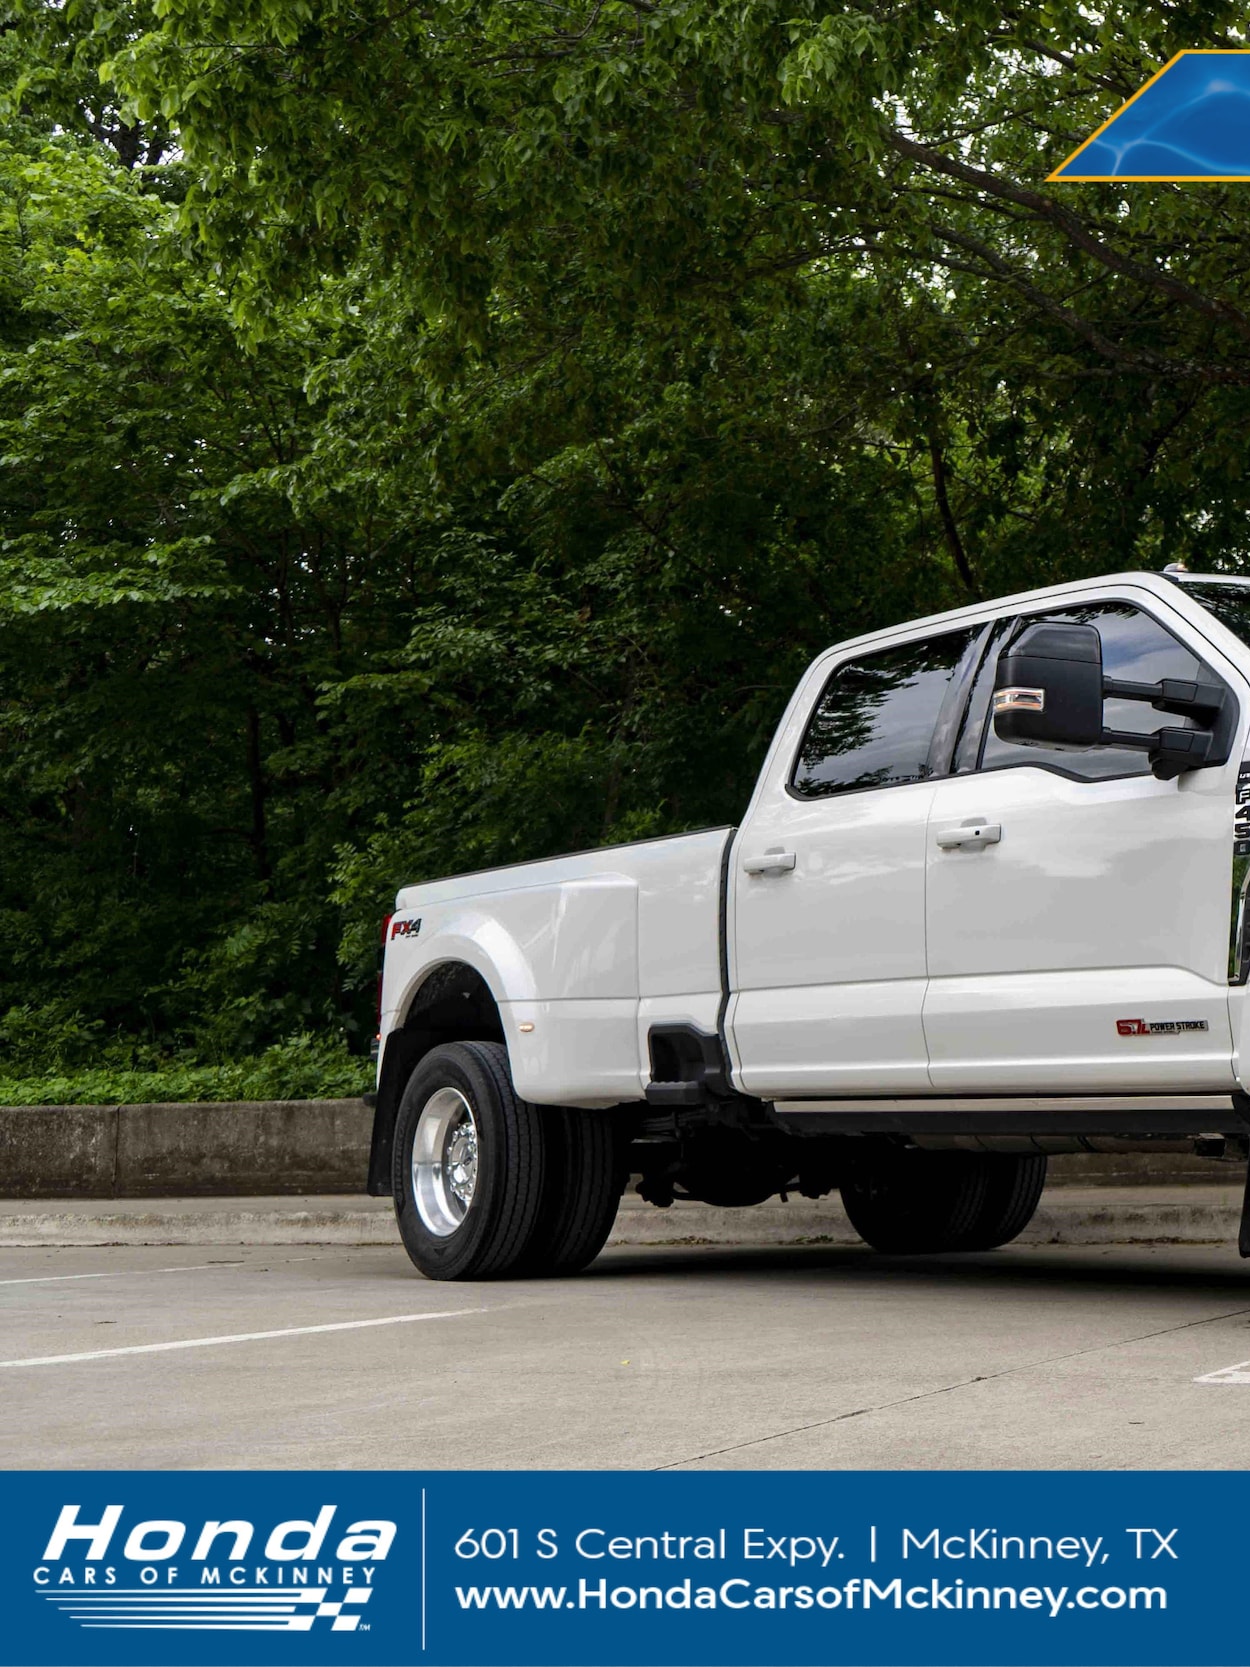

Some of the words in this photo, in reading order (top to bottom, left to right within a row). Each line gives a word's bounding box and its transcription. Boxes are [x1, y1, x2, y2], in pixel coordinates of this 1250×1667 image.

[391, 918, 422, 940] FX4
[1149, 1021, 1176, 1032] POWER
[1176, 1020, 1206, 1031] STROKE
